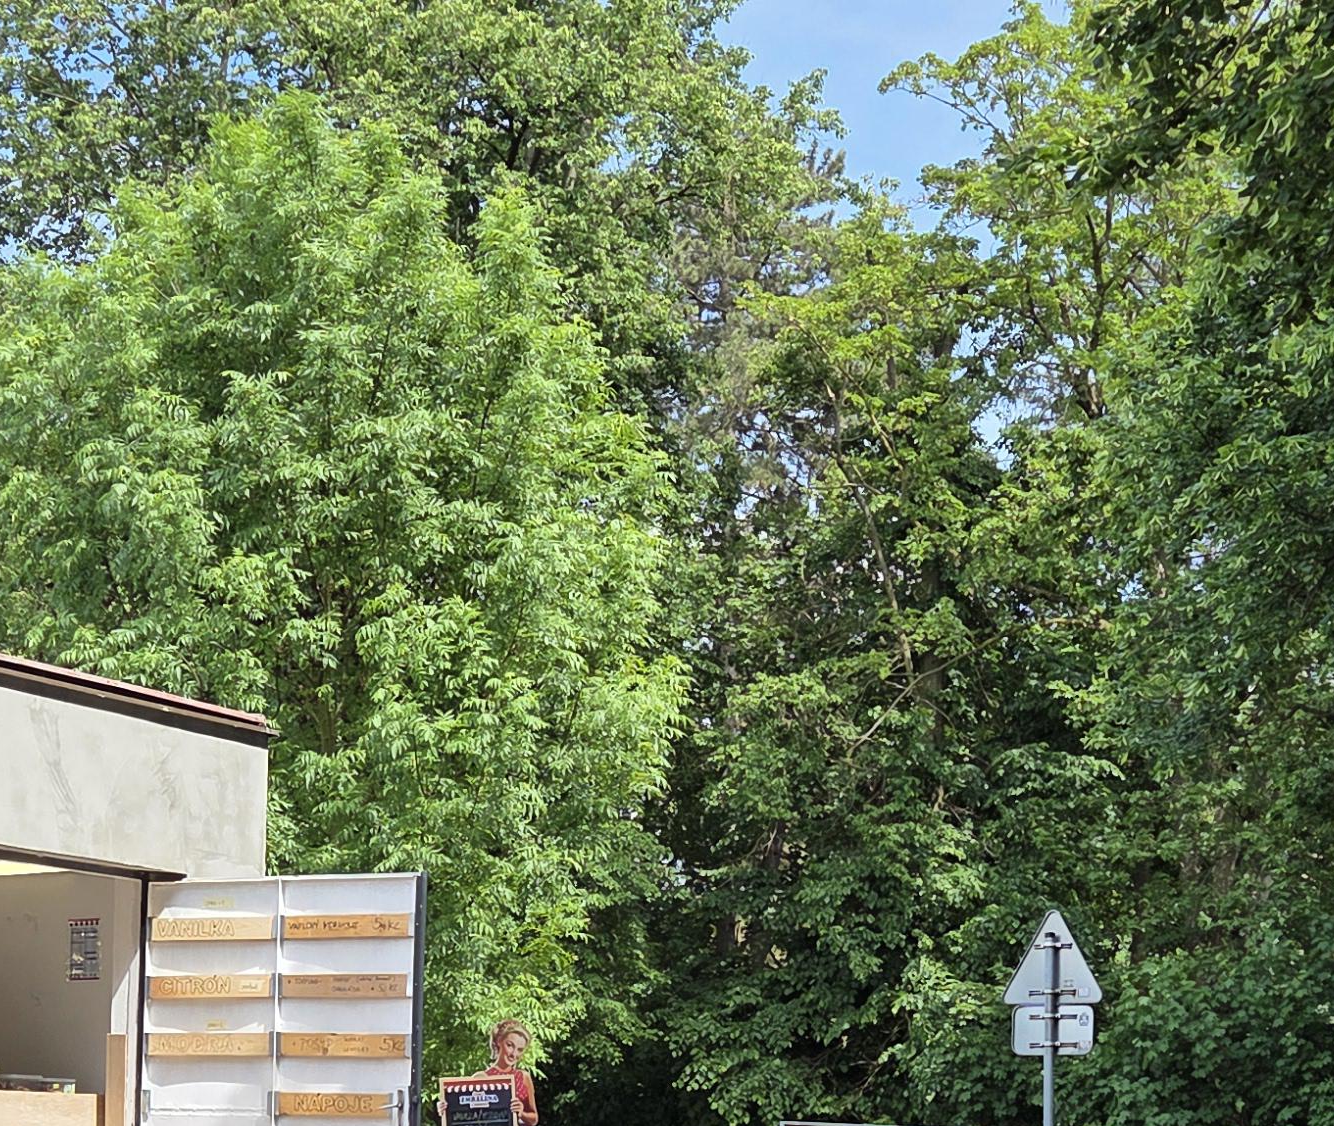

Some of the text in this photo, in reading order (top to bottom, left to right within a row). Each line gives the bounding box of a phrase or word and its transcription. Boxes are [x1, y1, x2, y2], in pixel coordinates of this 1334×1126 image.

[157, 920, 235, 938] VANILKA
[159, 975, 231, 995] CITRÓN
[293, 1093, 373, 1113] NÁPOJE
